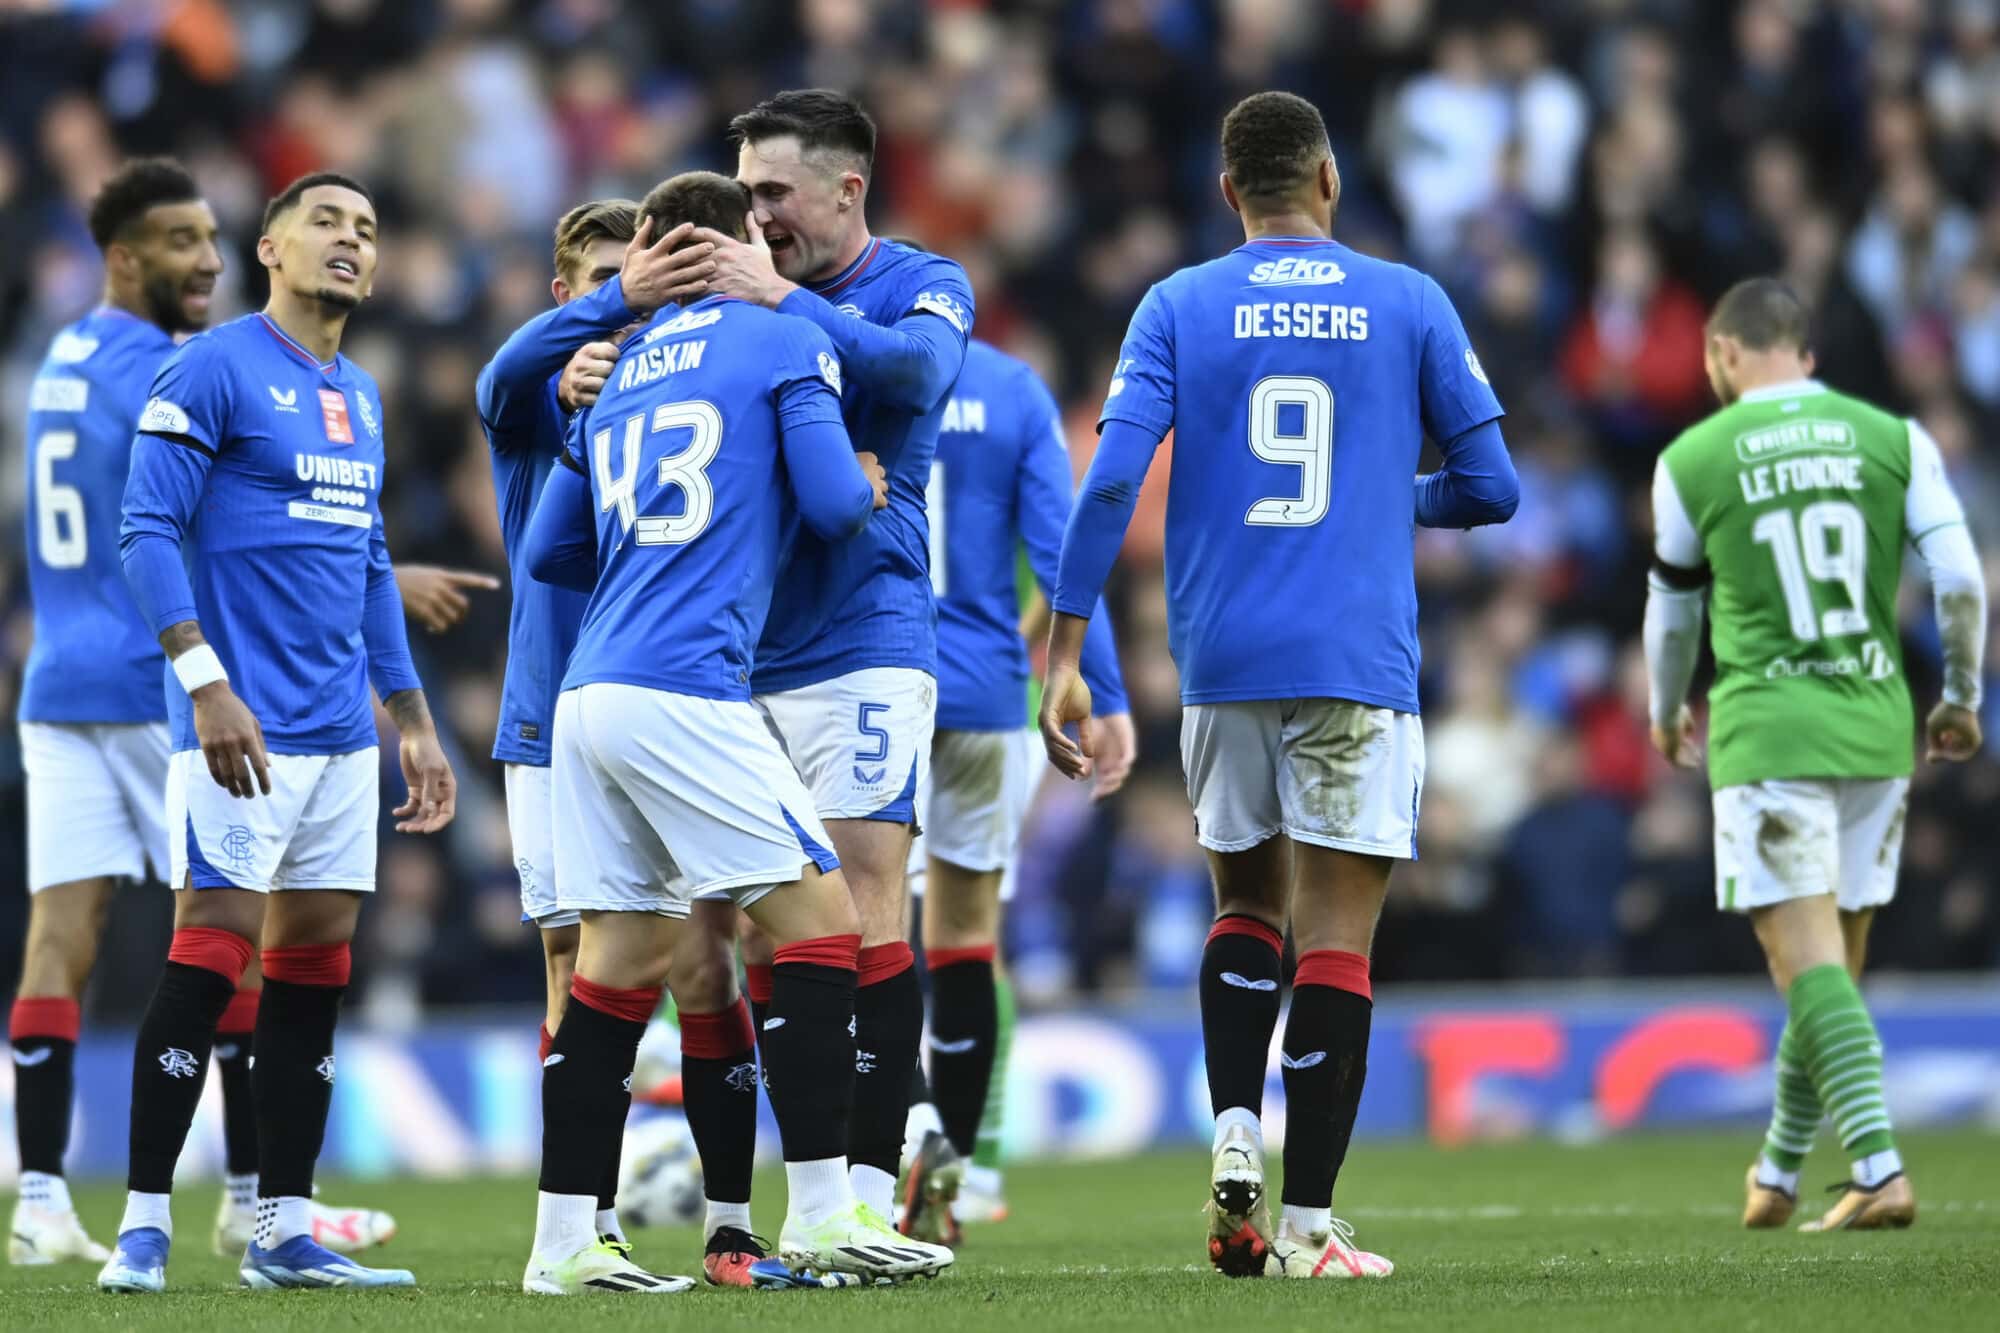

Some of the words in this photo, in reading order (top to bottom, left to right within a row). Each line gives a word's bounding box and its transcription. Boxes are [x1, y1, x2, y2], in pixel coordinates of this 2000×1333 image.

[1247, 257, 1346, 287] SEKO
[1234, 302, 1369, 342] DESSERS
[618, 339, 708, 392] RASKIN
[295, 453, 376, 491] UNIBET
[593, 400, 724, 547] 43
[1243, 375, 1334, 528] 9
[35, 430, 88, 570] 6
[1738, 465, 1776, 504] LE
[1752, 501, 1870, 643] 19
[854, 702, 891, 762] 5
